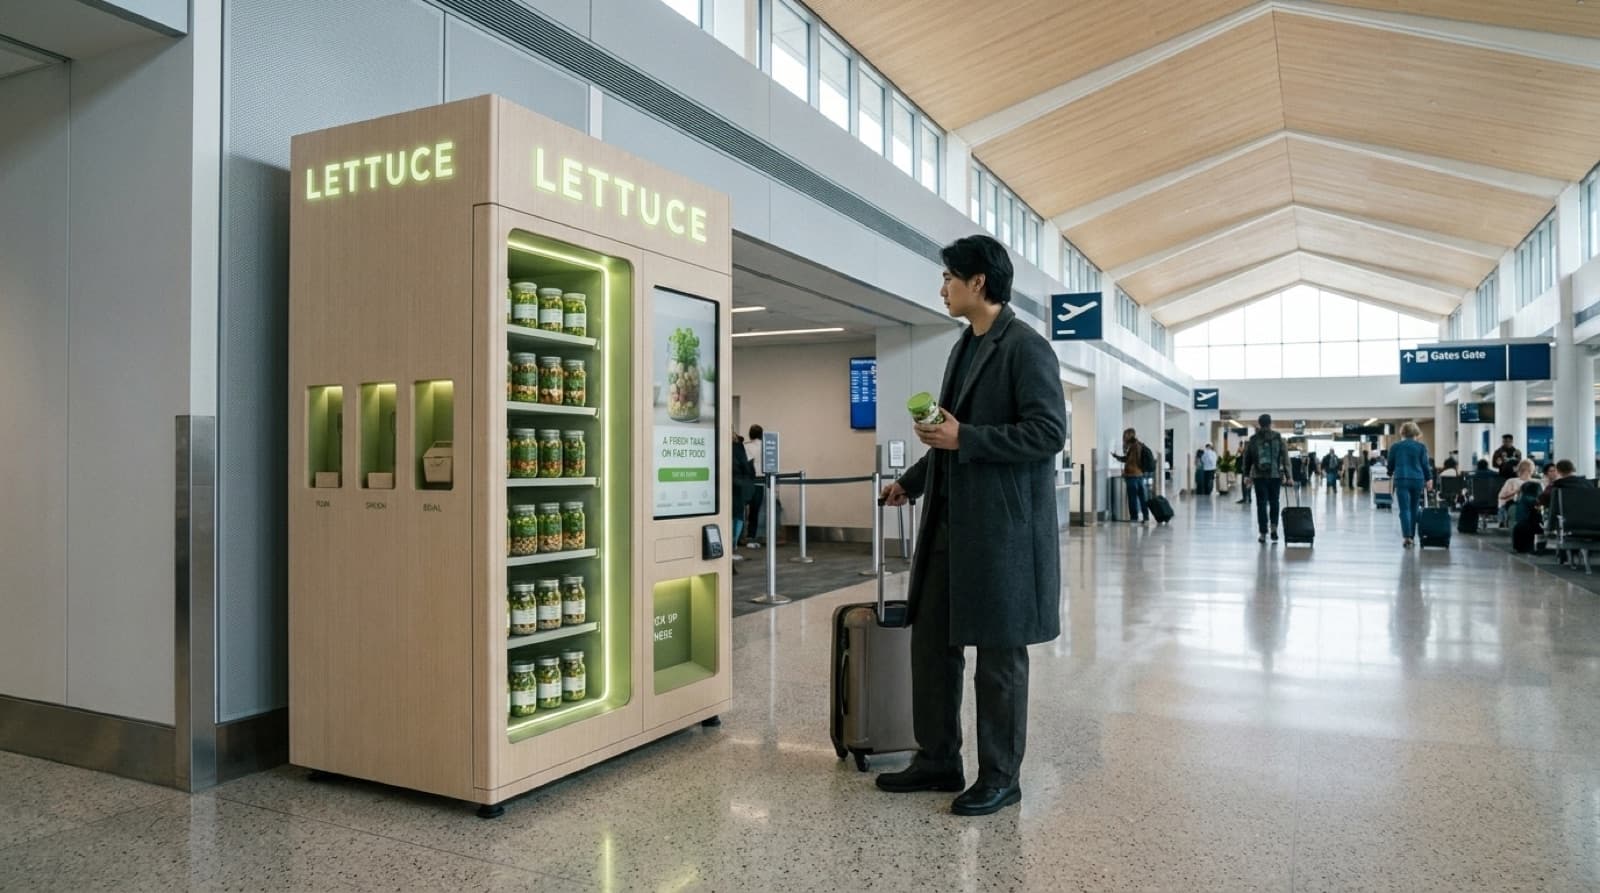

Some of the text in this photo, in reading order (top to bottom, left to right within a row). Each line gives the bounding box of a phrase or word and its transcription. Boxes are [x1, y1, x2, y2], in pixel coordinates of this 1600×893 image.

[306, 141, 453, 200] LETTUCE
[536, 147, 707, 243] LETTUCE
[1430, 350, 1486, 361] Gates Gate
